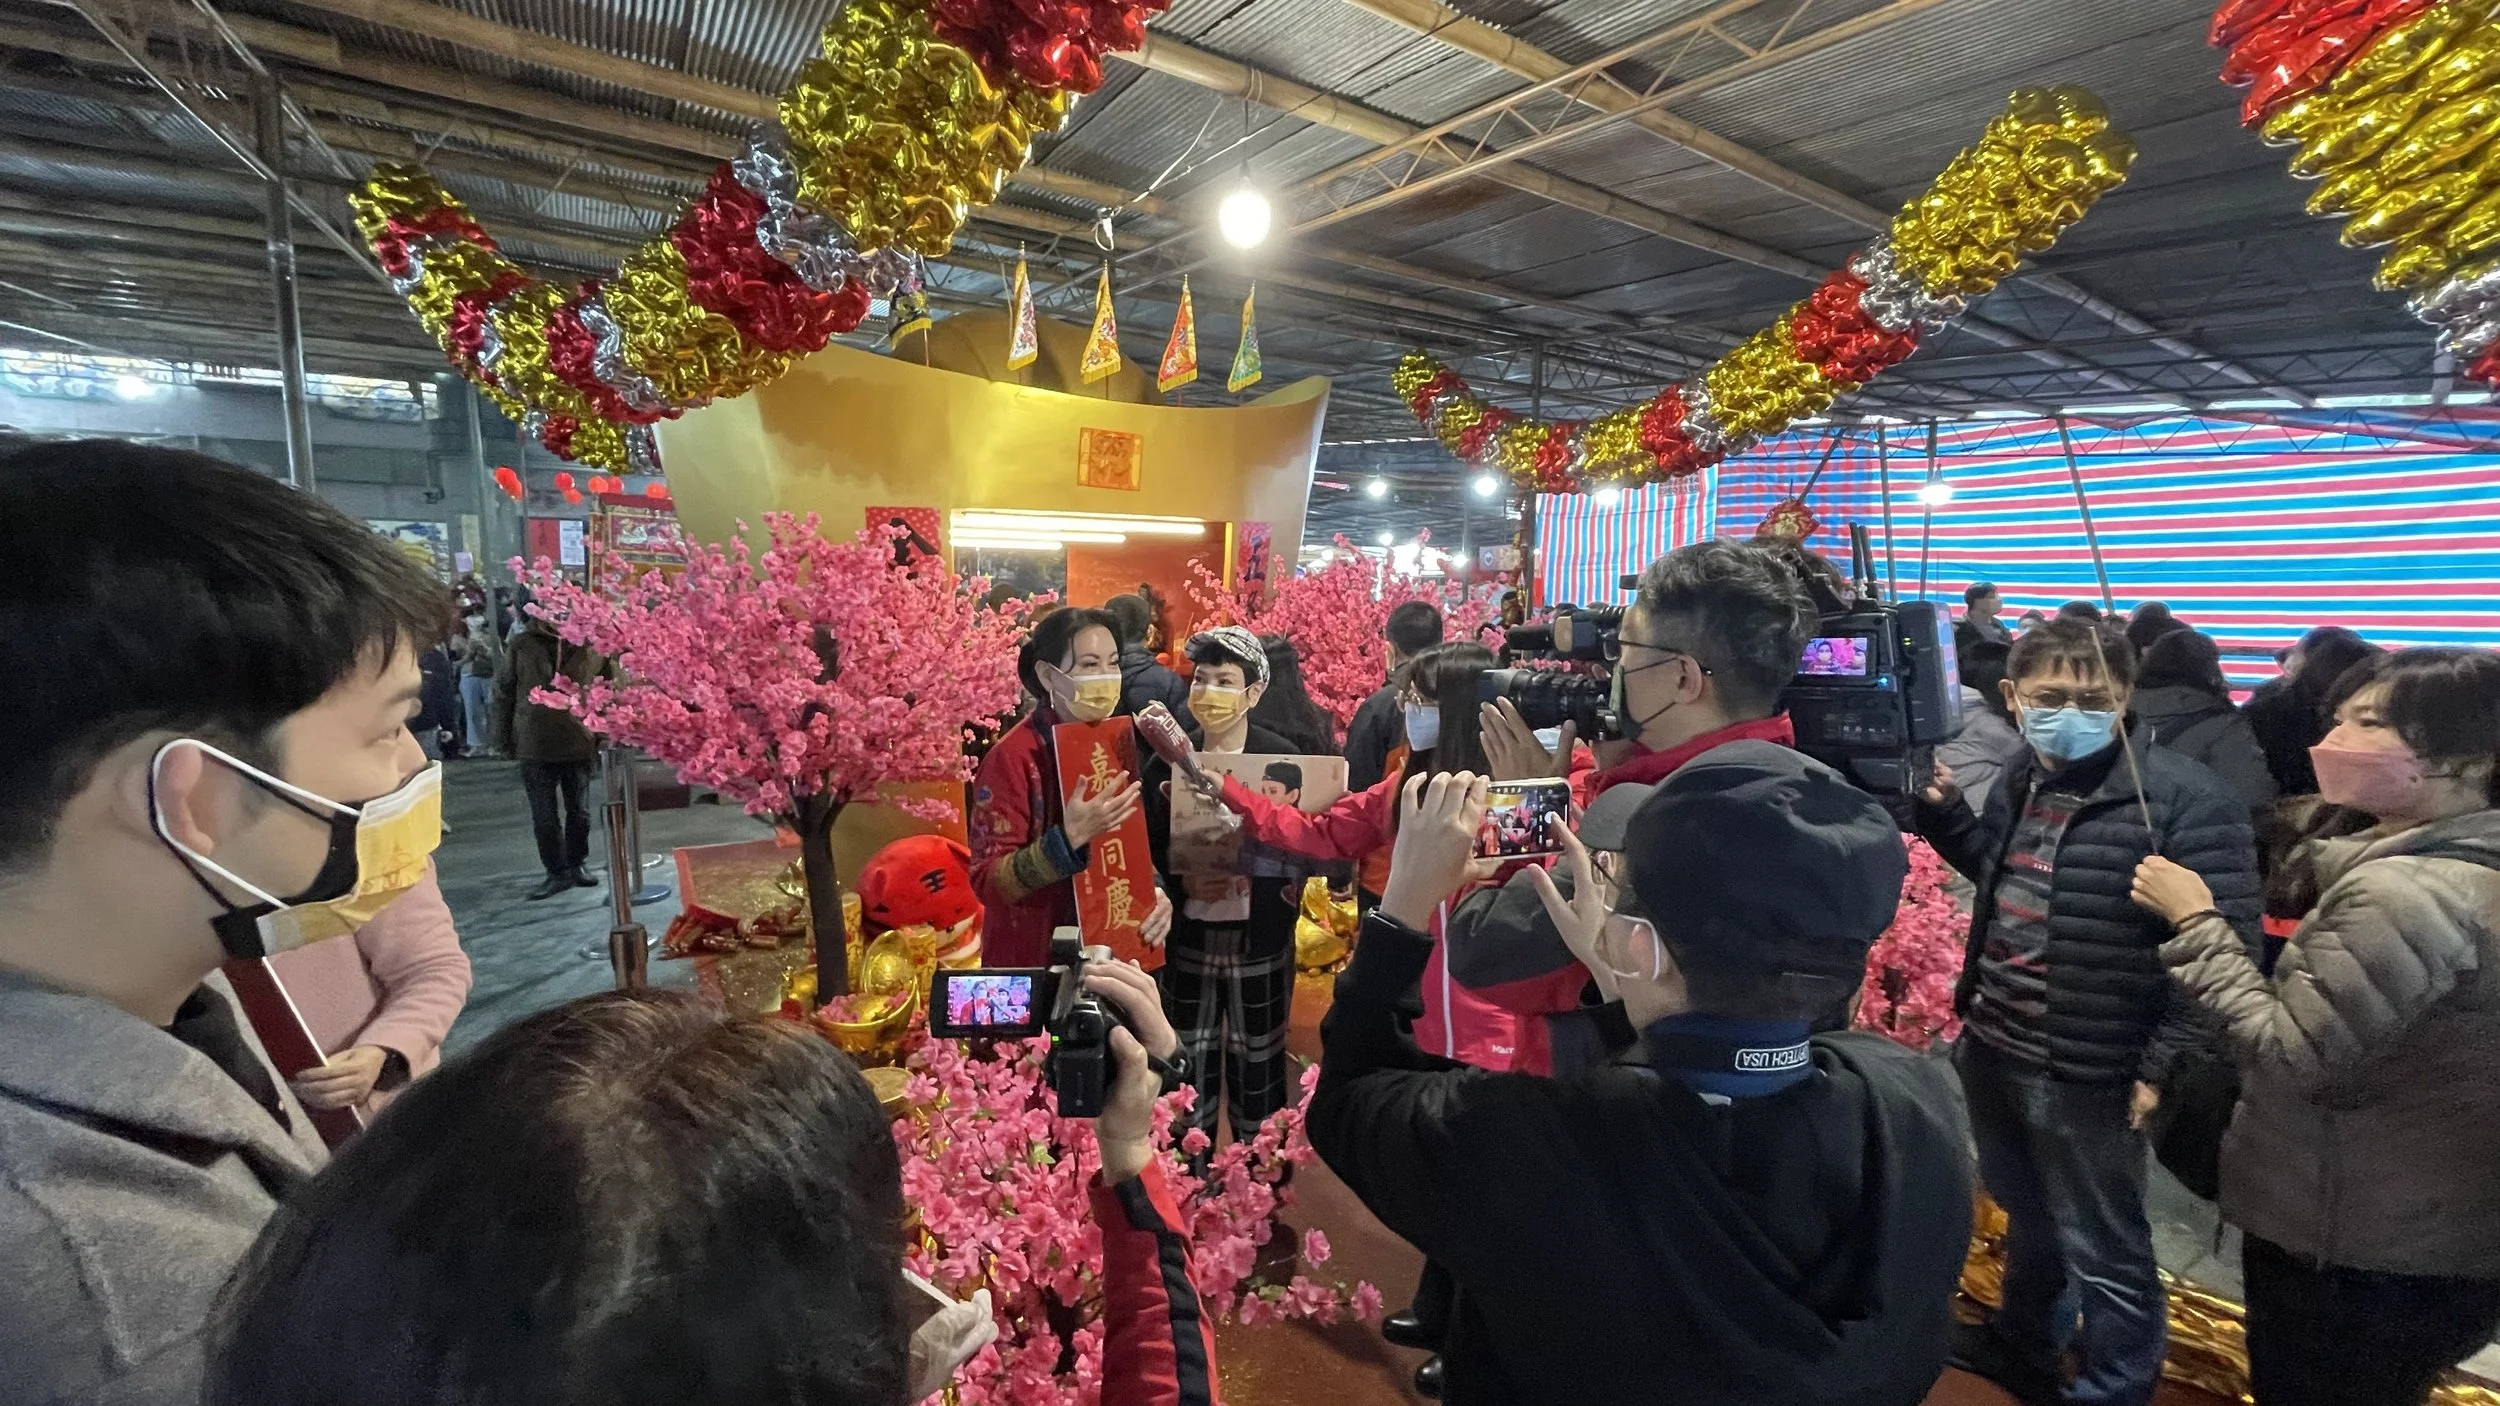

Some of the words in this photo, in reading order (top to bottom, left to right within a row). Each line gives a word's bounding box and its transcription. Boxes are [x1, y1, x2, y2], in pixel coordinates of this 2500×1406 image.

[1087, 741, 1140, 931] 嘉同慶
[1742, 1053, 1769, 1067] USA
